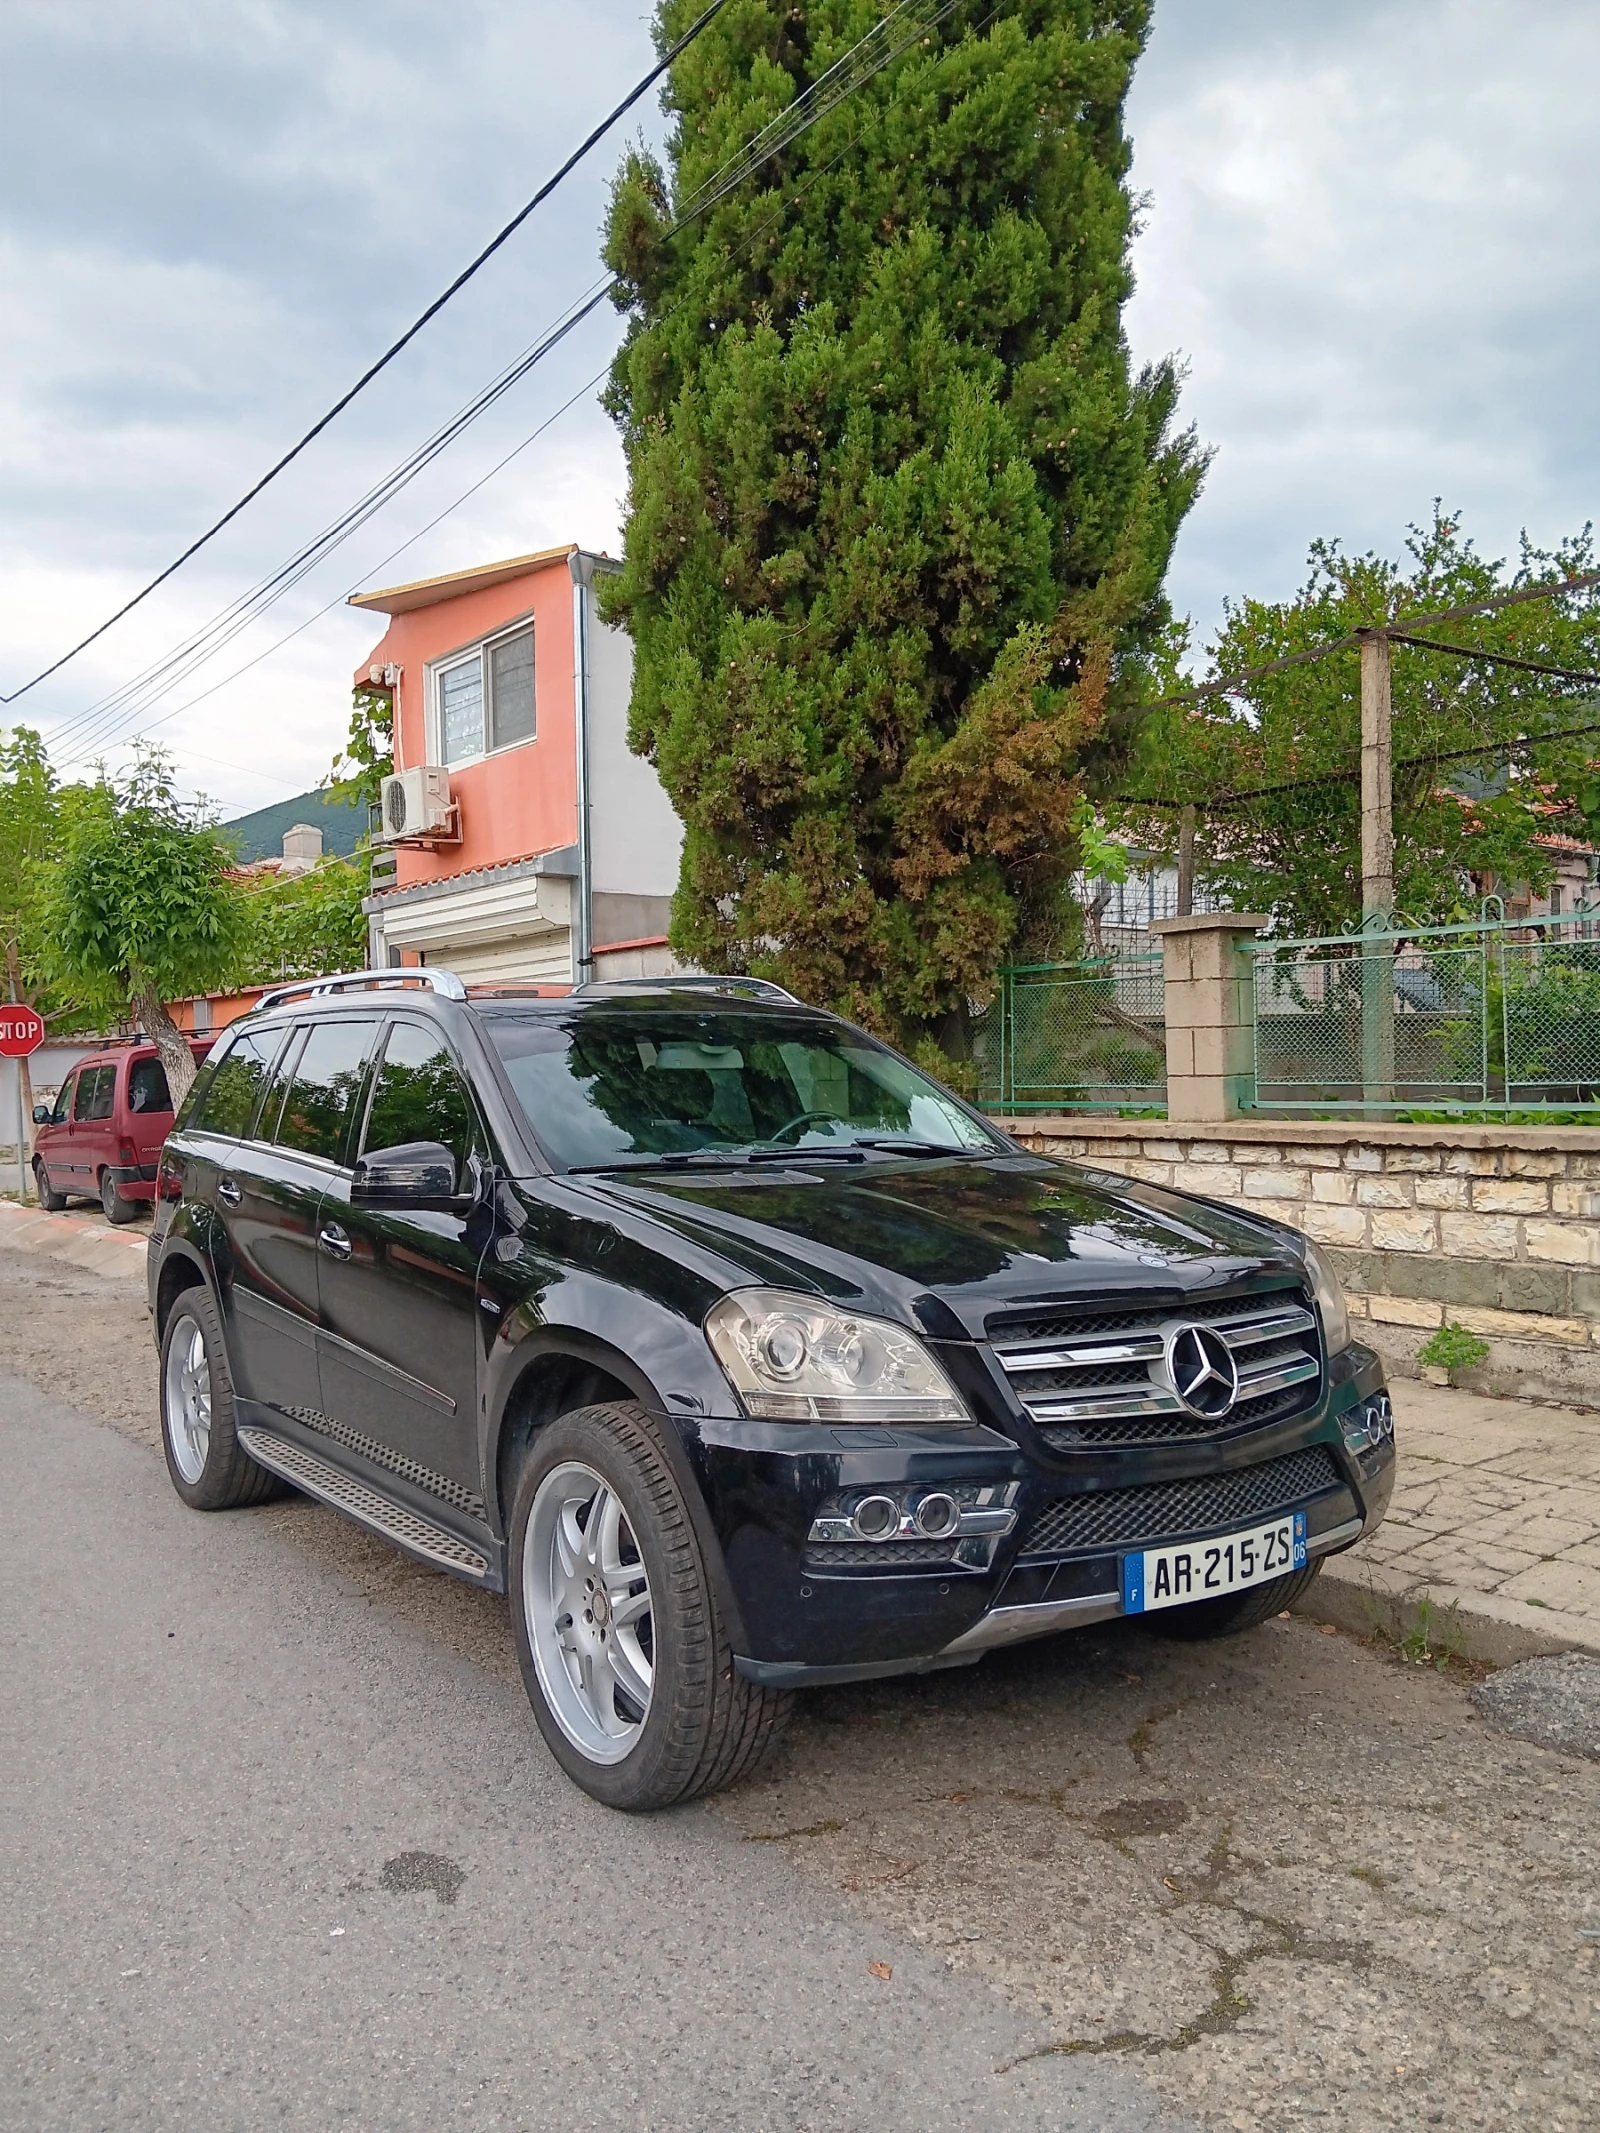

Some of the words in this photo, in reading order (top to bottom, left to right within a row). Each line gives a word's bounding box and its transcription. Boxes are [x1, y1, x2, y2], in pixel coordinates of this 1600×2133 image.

[1294, 1541, 1306, 1561] 06
[1154, 1527, 1289, 1598] AR-215-ZS
[1131, 1589, 1137, 1601] F
